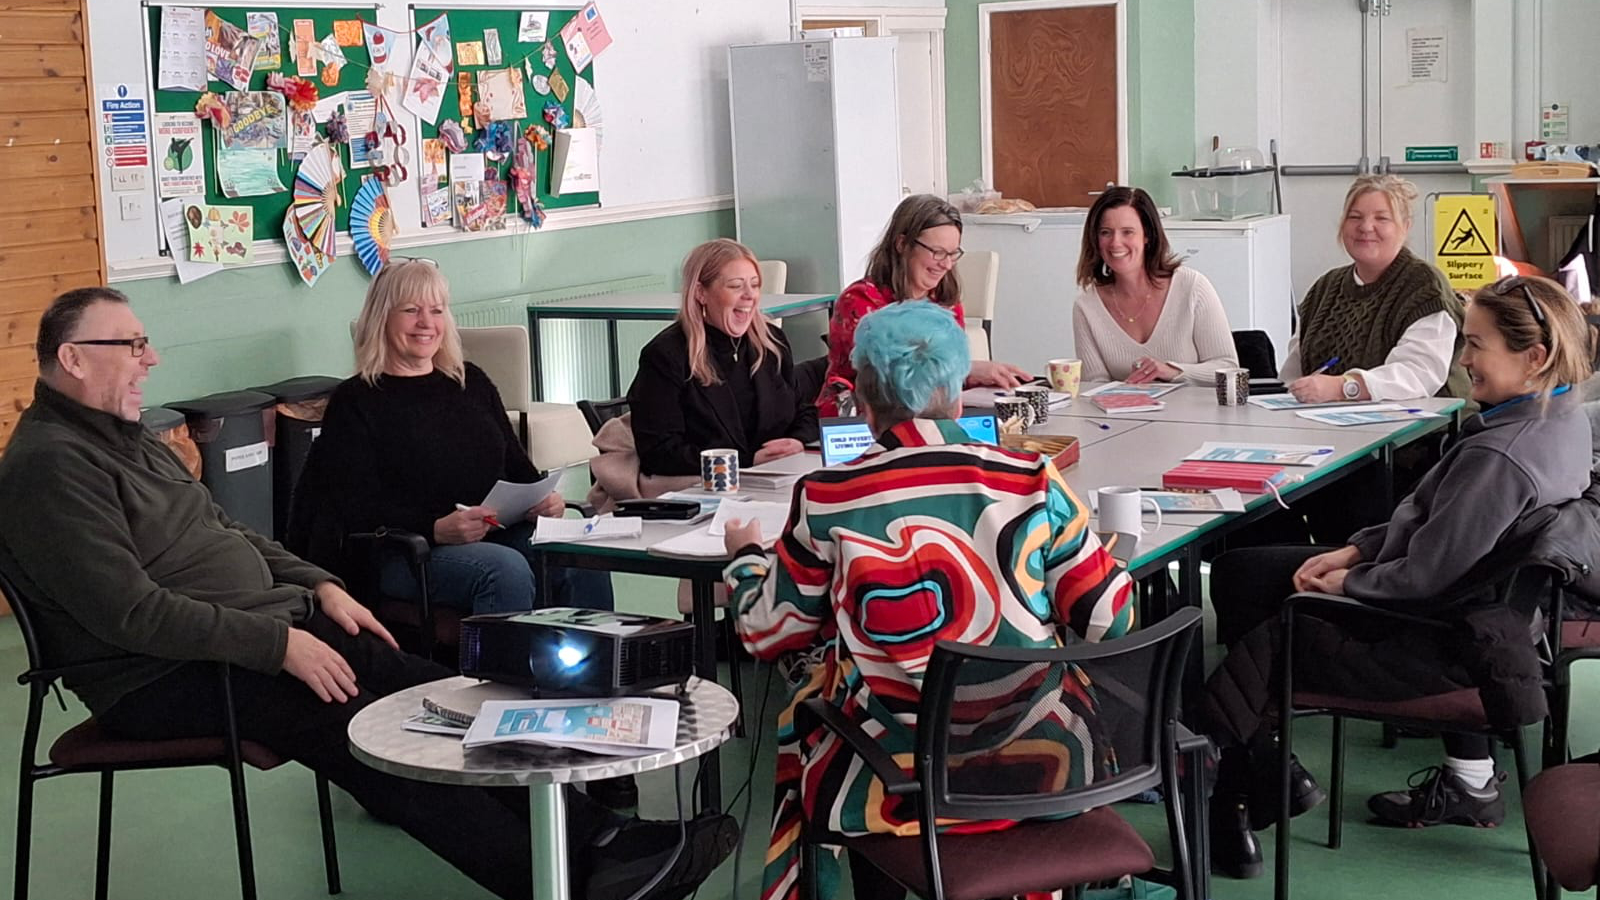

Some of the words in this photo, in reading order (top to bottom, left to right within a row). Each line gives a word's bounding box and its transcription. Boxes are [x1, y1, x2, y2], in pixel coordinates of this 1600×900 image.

[211, 43, 231, 60] LOVE
[105, 101, 119, 110] Fire
[120, 100, 141, 109] Action
[233, 104, 273, 133] GOODBYE
[1446, 259, 1484, 270] Slippery
